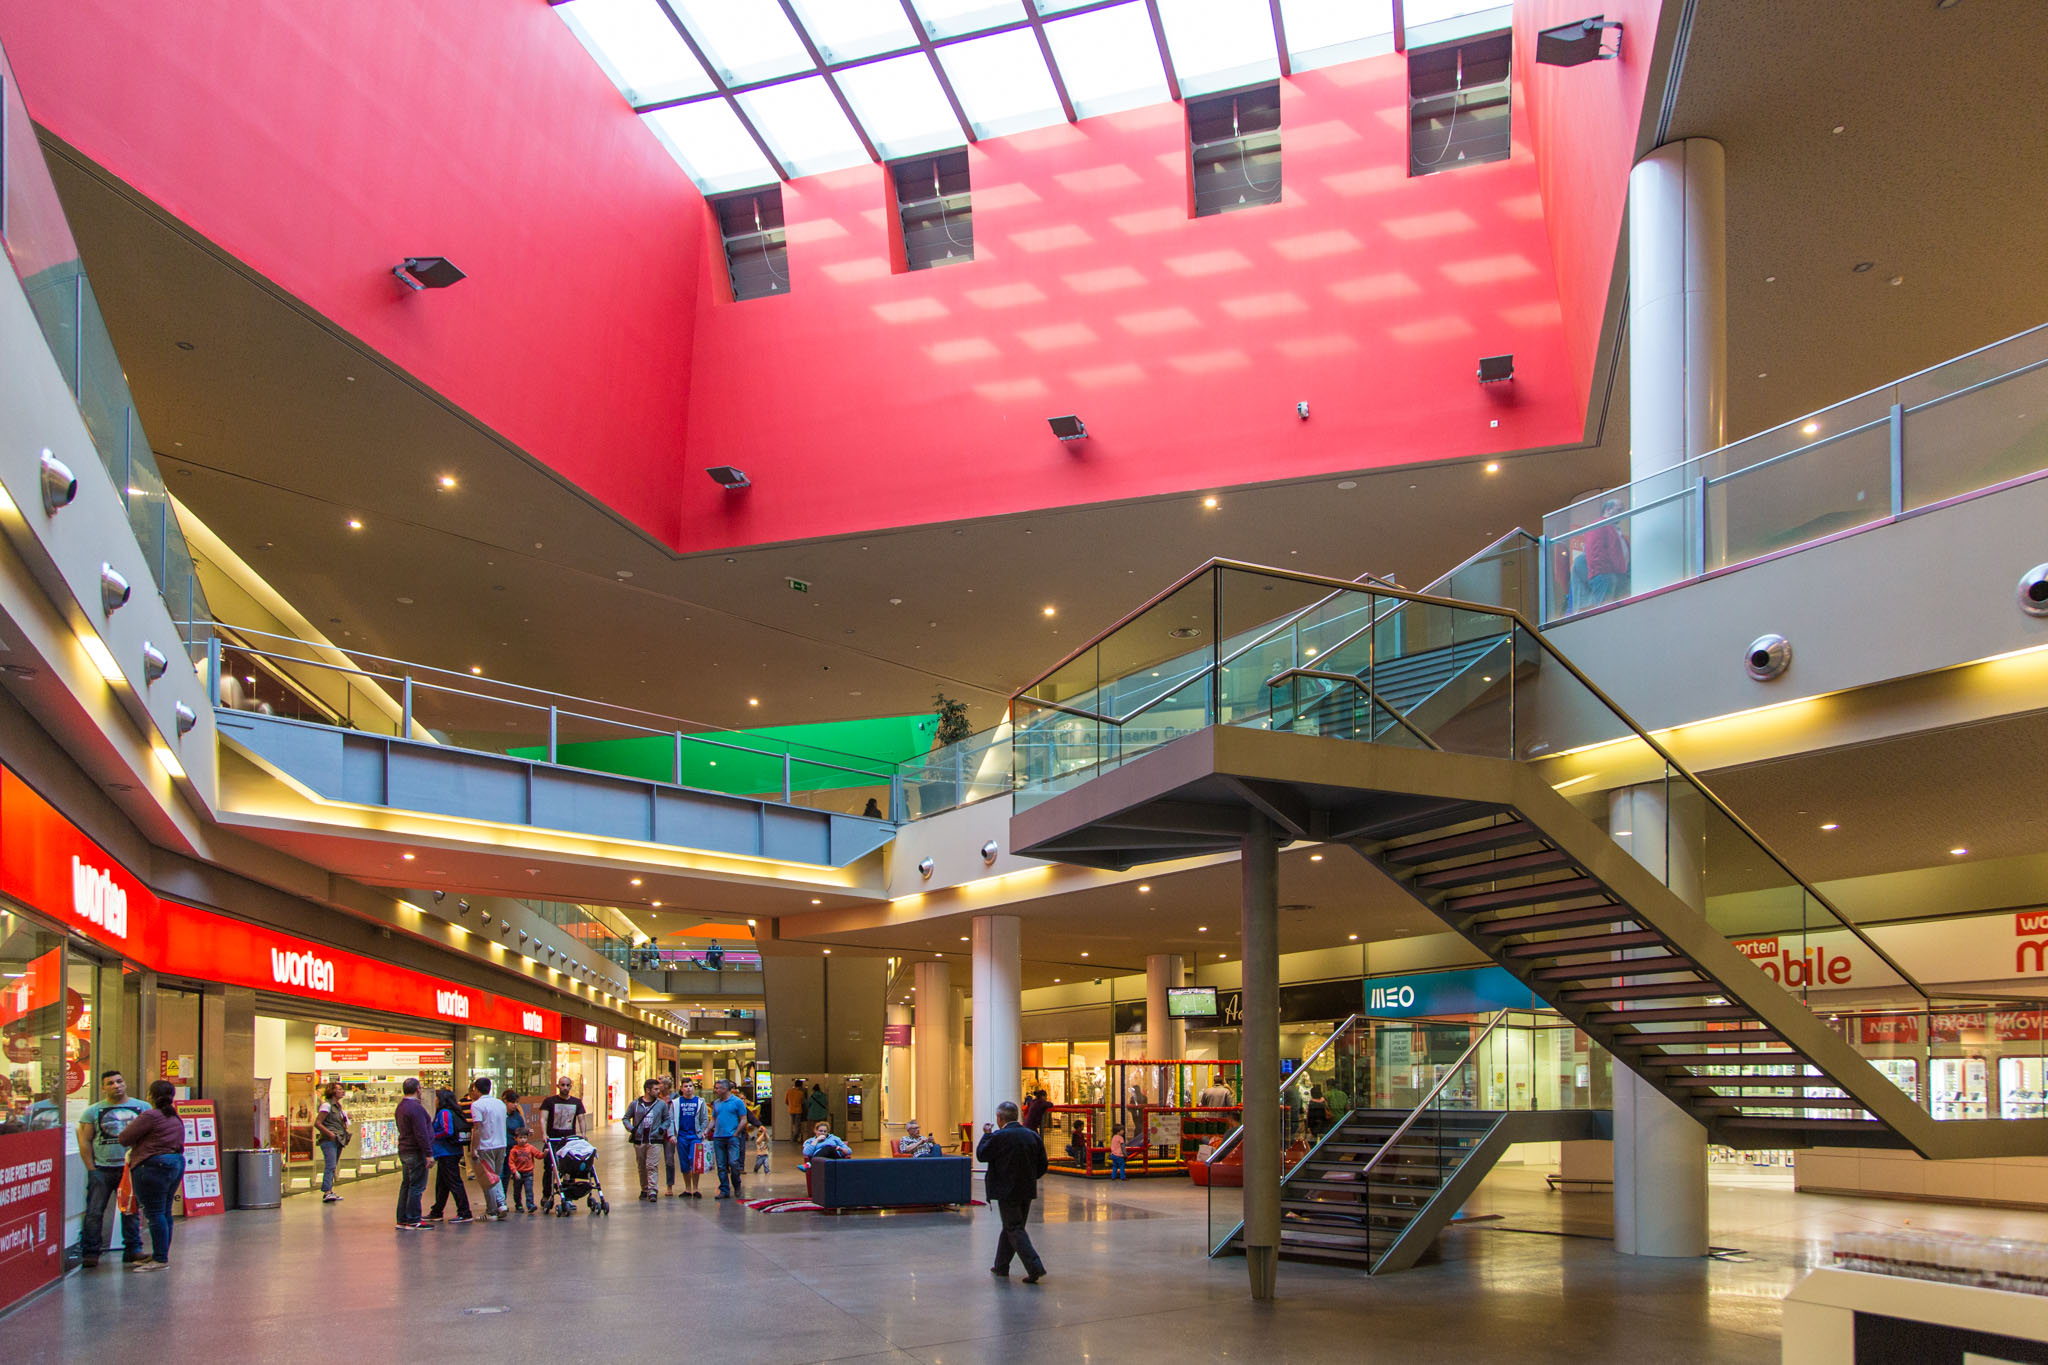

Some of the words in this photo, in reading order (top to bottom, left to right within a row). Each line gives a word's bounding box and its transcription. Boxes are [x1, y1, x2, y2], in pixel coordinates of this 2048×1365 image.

[72, 855, 127, 939] worten
[271, 947, 334, 993] worten
[436, 989, 469, 1019] worten
[1371, 985, 1415, 1009] MEO
[522, 1011, 543, 1033] worten
[1869, 1021, 1895, 1034] NET
[5, 1166, 16, 1184] QUE
[16, 1163, 28, 1181] PODE
[28, 1161, 37, 1177] TER
[37, 1158, 53, 1175] ACESSO
[10, 1186, 18, 1203] DE
[18, 1182, 31, 1201] 5.000
[31, 1177, 51, 1197] ARTIGOS?
[0, 1223, 28, 1253] worten.pt
